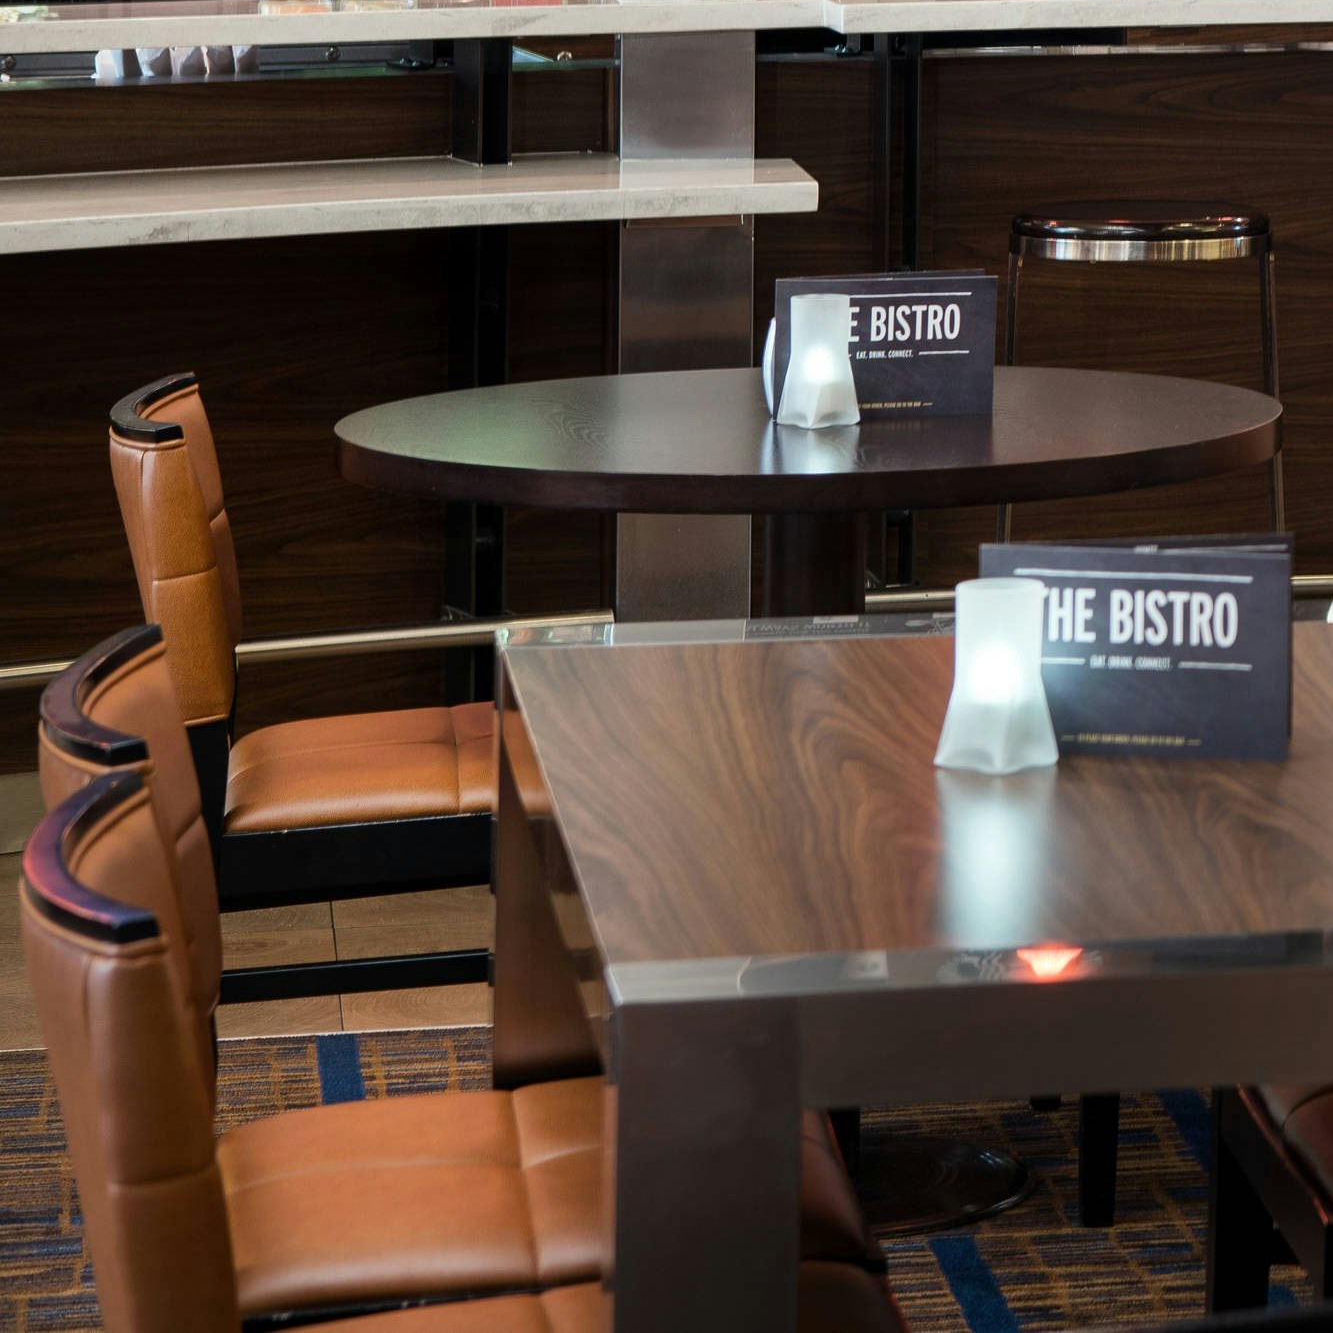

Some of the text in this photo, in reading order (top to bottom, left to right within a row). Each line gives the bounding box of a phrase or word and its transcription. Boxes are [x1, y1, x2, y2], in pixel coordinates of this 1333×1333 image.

[870, 304, 960, 342] BISTRO
[856, 350, 913, 359] EAT. DRINK. CONNECT.
[1110, 589, 1239, 649] BISTRO
